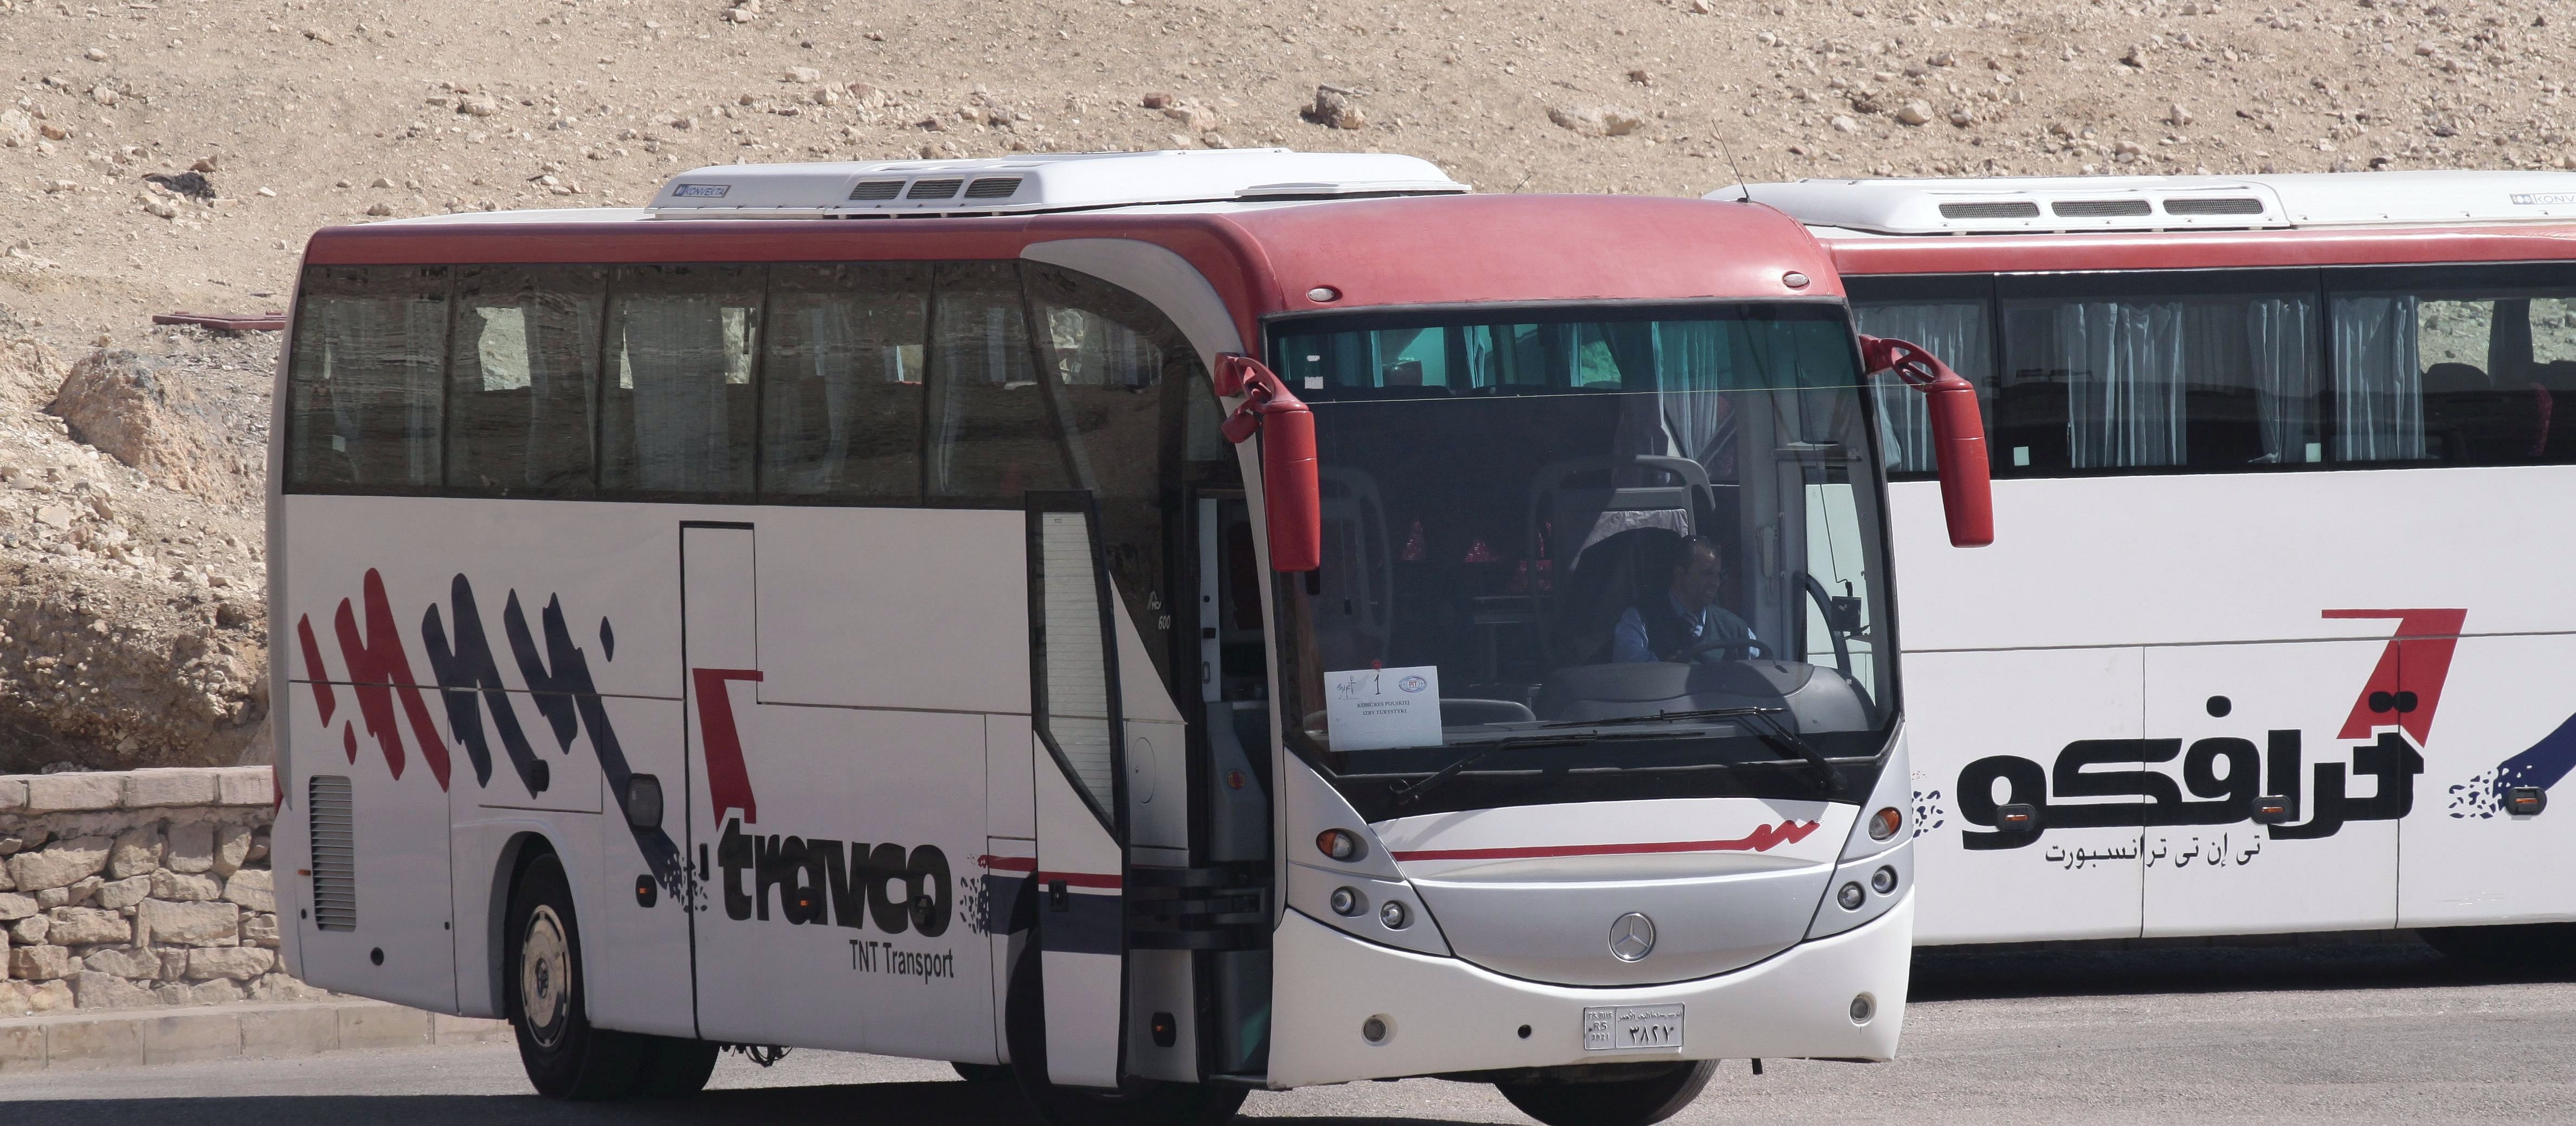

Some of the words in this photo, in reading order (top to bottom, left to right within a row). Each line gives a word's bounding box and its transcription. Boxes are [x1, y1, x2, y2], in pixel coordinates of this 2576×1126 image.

[1158, 614, 1171, 630] 600
[1956, 691, 2424, 850] ترافكو
[2045, 834, 2167, 870] ترانسبورت
[718, 818, 952, 937] travco
[849, 939, 878, 973] TNT
[883, 942, 954, 984] Transport
[1594, 1020, 1608, 1031] RS
